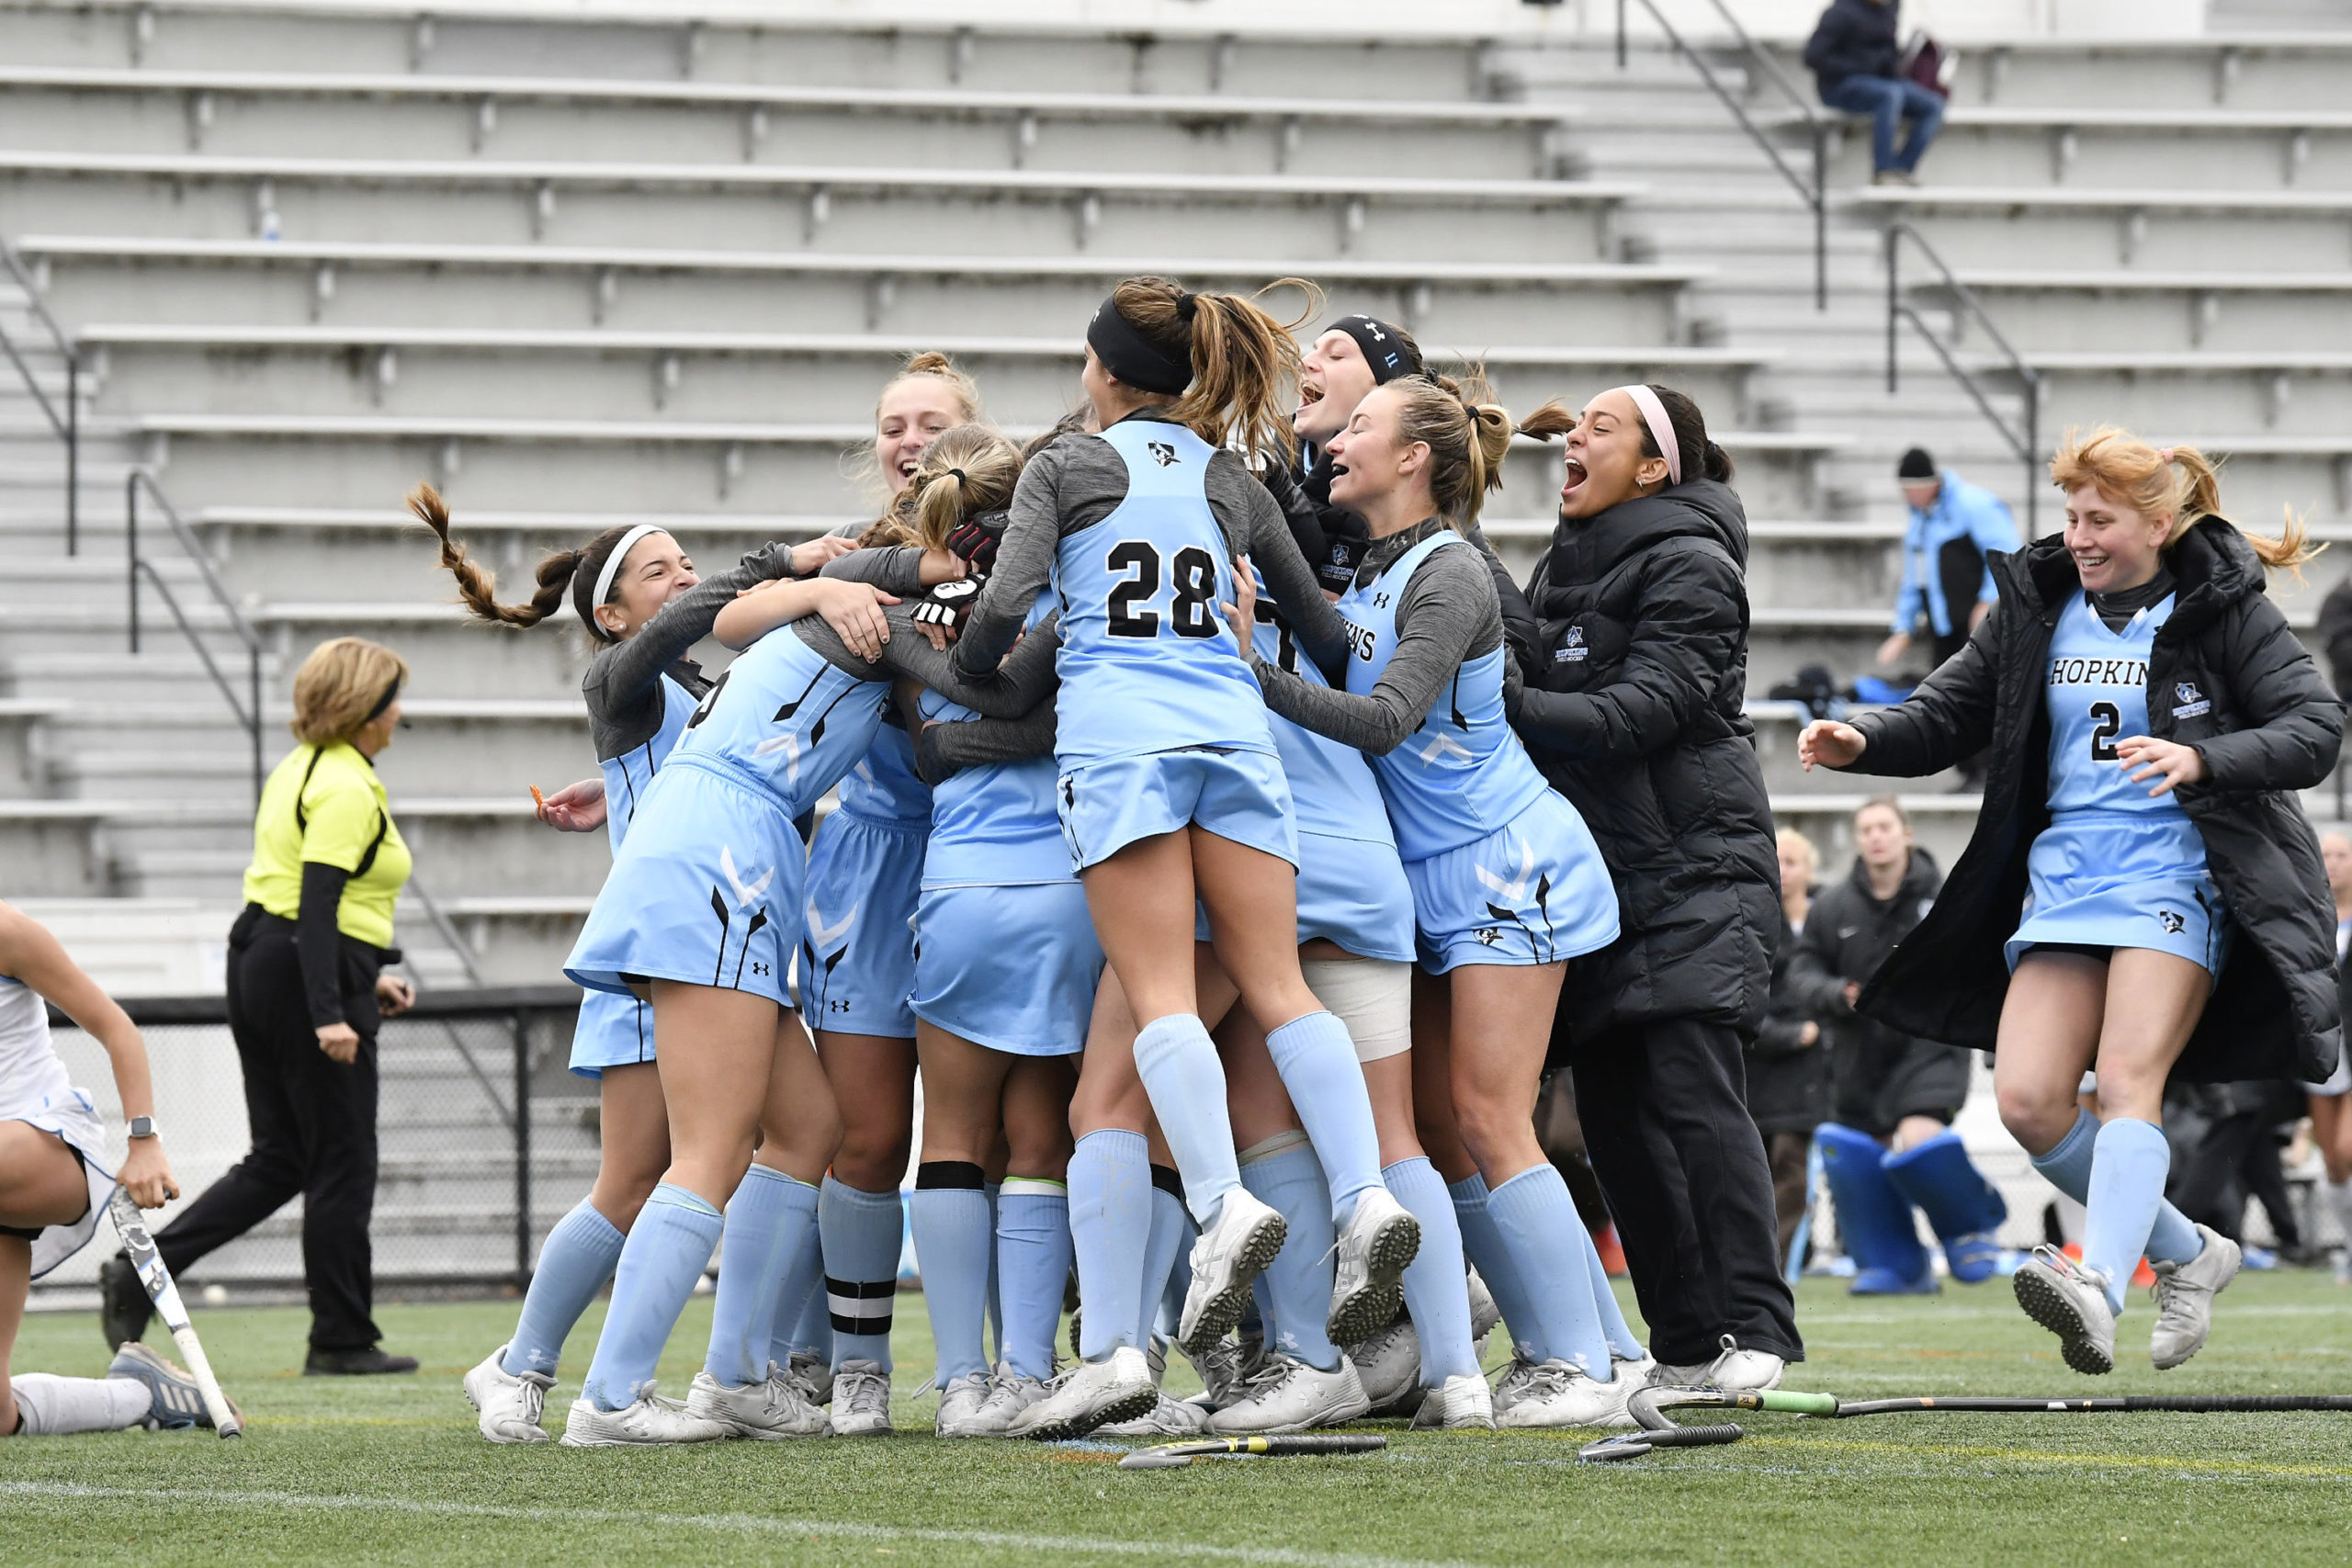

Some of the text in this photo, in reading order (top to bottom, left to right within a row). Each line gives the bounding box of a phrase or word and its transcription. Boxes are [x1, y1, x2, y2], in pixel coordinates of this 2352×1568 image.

[1385, 352, 1399, 368] 11
[1105, 539, 1221, 639] 28
[2050, 659, 2150, 686] HOPKIN
[2088, 701, 2121, 762] 2
